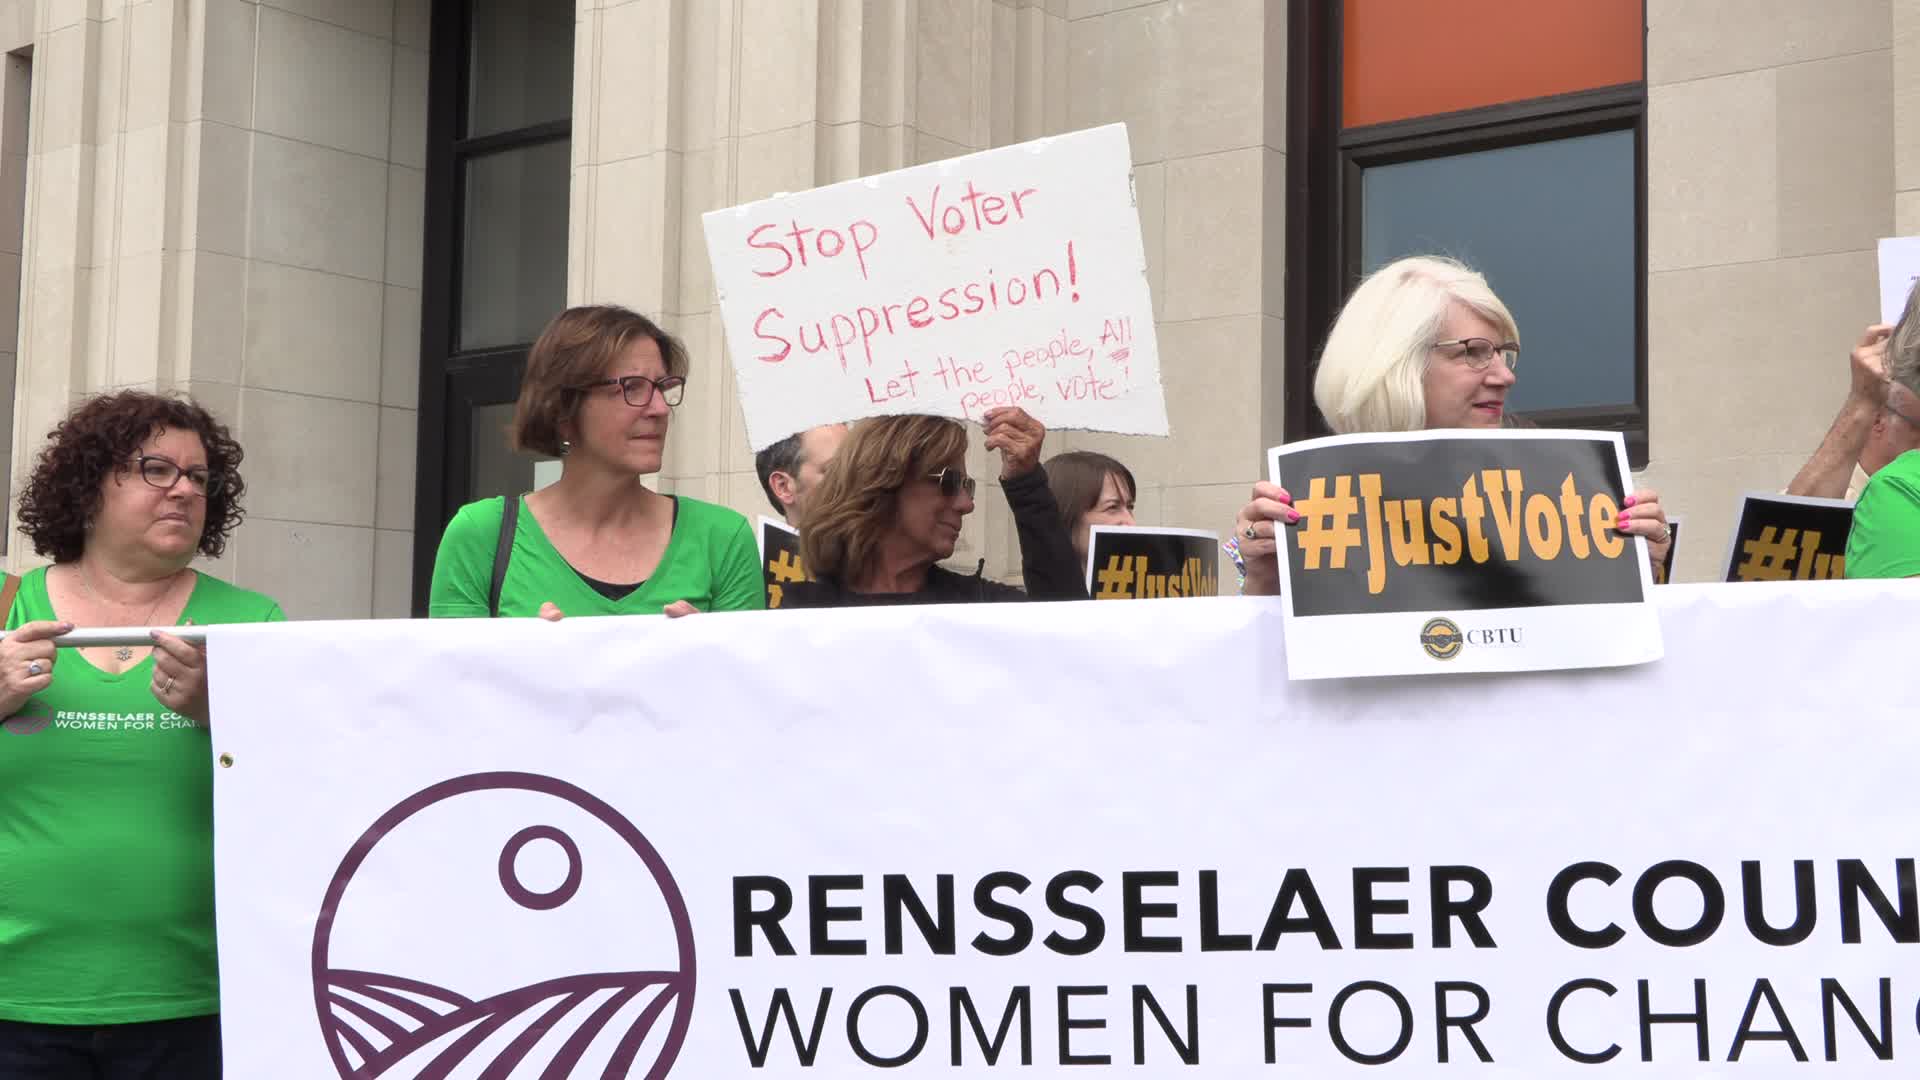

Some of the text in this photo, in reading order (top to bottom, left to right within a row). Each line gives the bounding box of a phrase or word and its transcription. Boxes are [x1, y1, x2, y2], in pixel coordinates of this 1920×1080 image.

[746, 181, 1039, 280] Stop Voter
[752, 240, 1080, 373] Suppression!
[864, 318, 1133, 404] Let the people, All
[1294, 469, 1625, 594] #JustVote
[1737, 525, 1845, 581] #Ju
[1466, 627, 1523, 645] CBTU
[55, 720, 118, 730] WOMEN
[124, 721, 154, 730] FOR
[56, 711, 154, 721] RENSSELAER
[732, 857, 1920, 957] RENSSELAER COUN
[728, 977, 1920, 1068] WOMEN FOR CHAN
